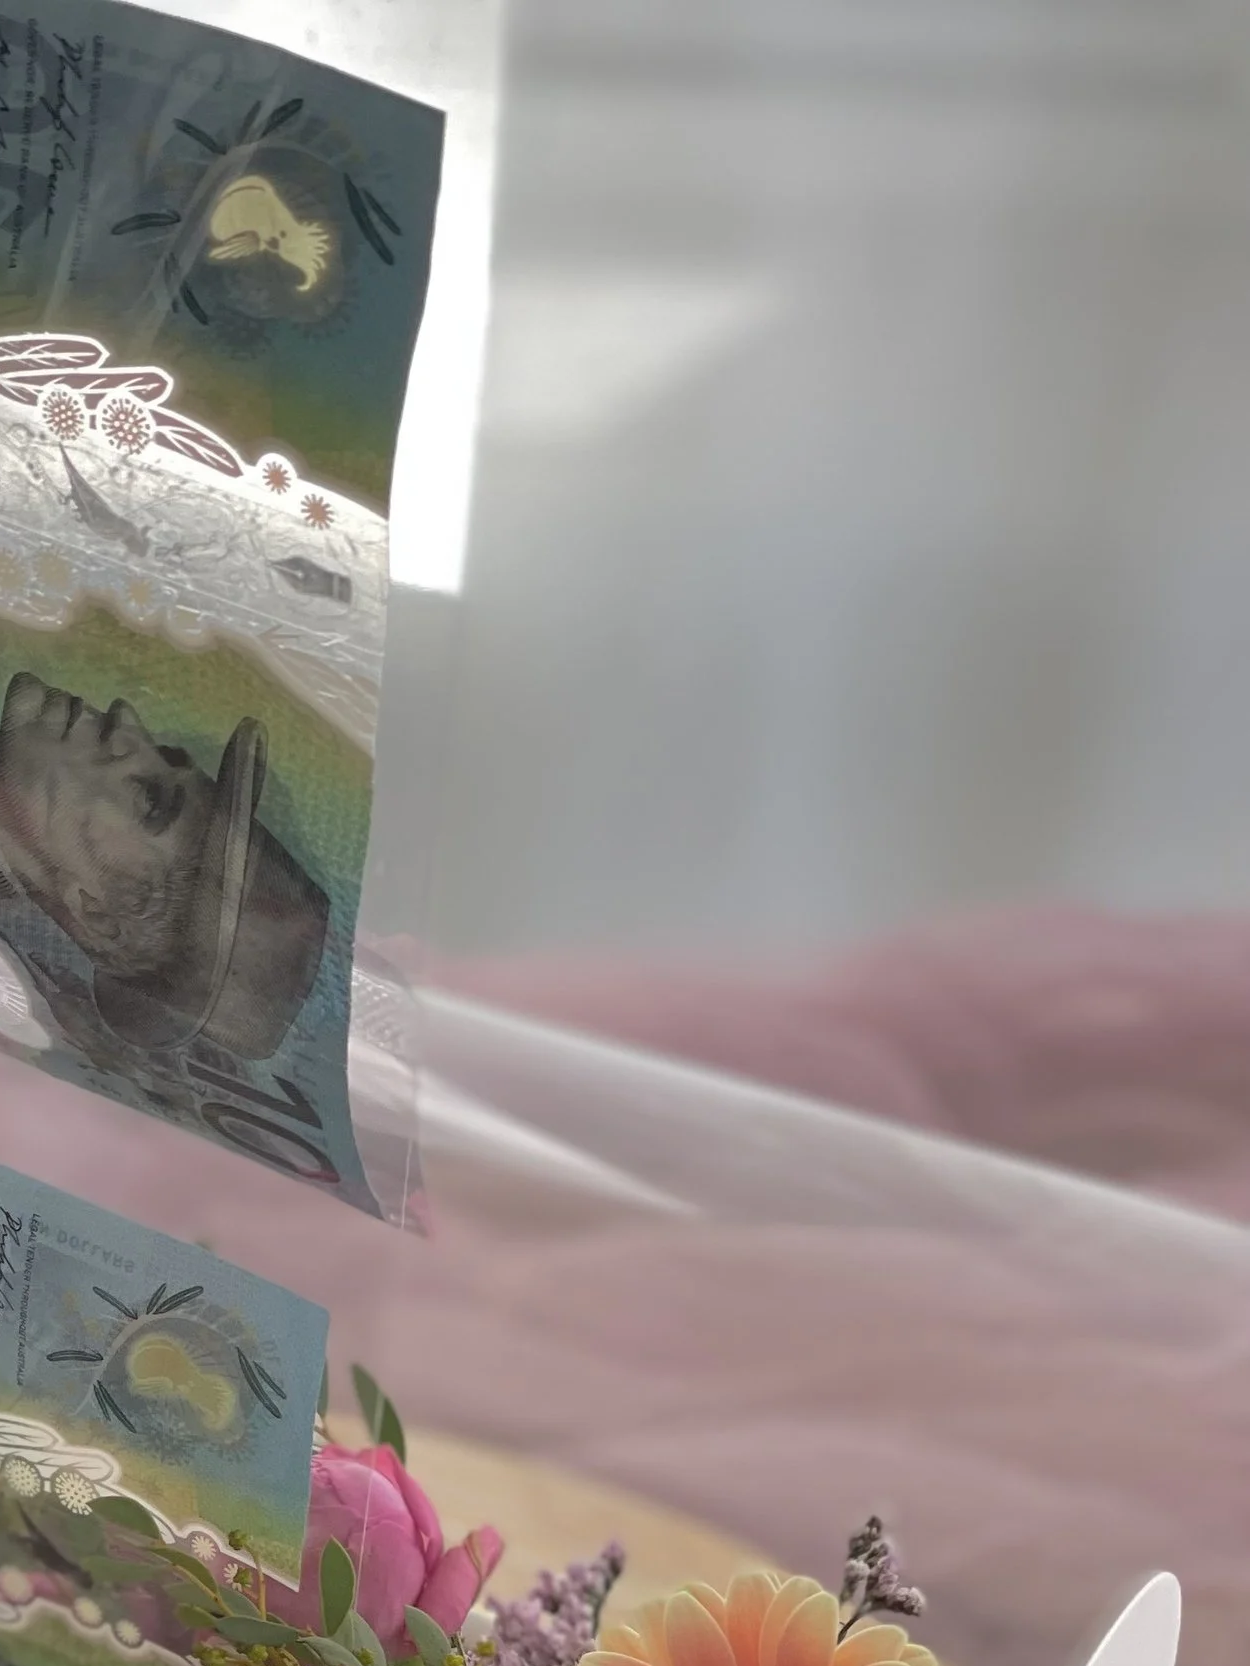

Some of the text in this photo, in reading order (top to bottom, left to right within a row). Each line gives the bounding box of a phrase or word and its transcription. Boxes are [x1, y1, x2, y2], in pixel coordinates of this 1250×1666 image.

[180, 1053, 341, 1183] 10
[16, 1213, 41, 1386] LEGAL TENDER THROUGHOUT AUSTRALIA
